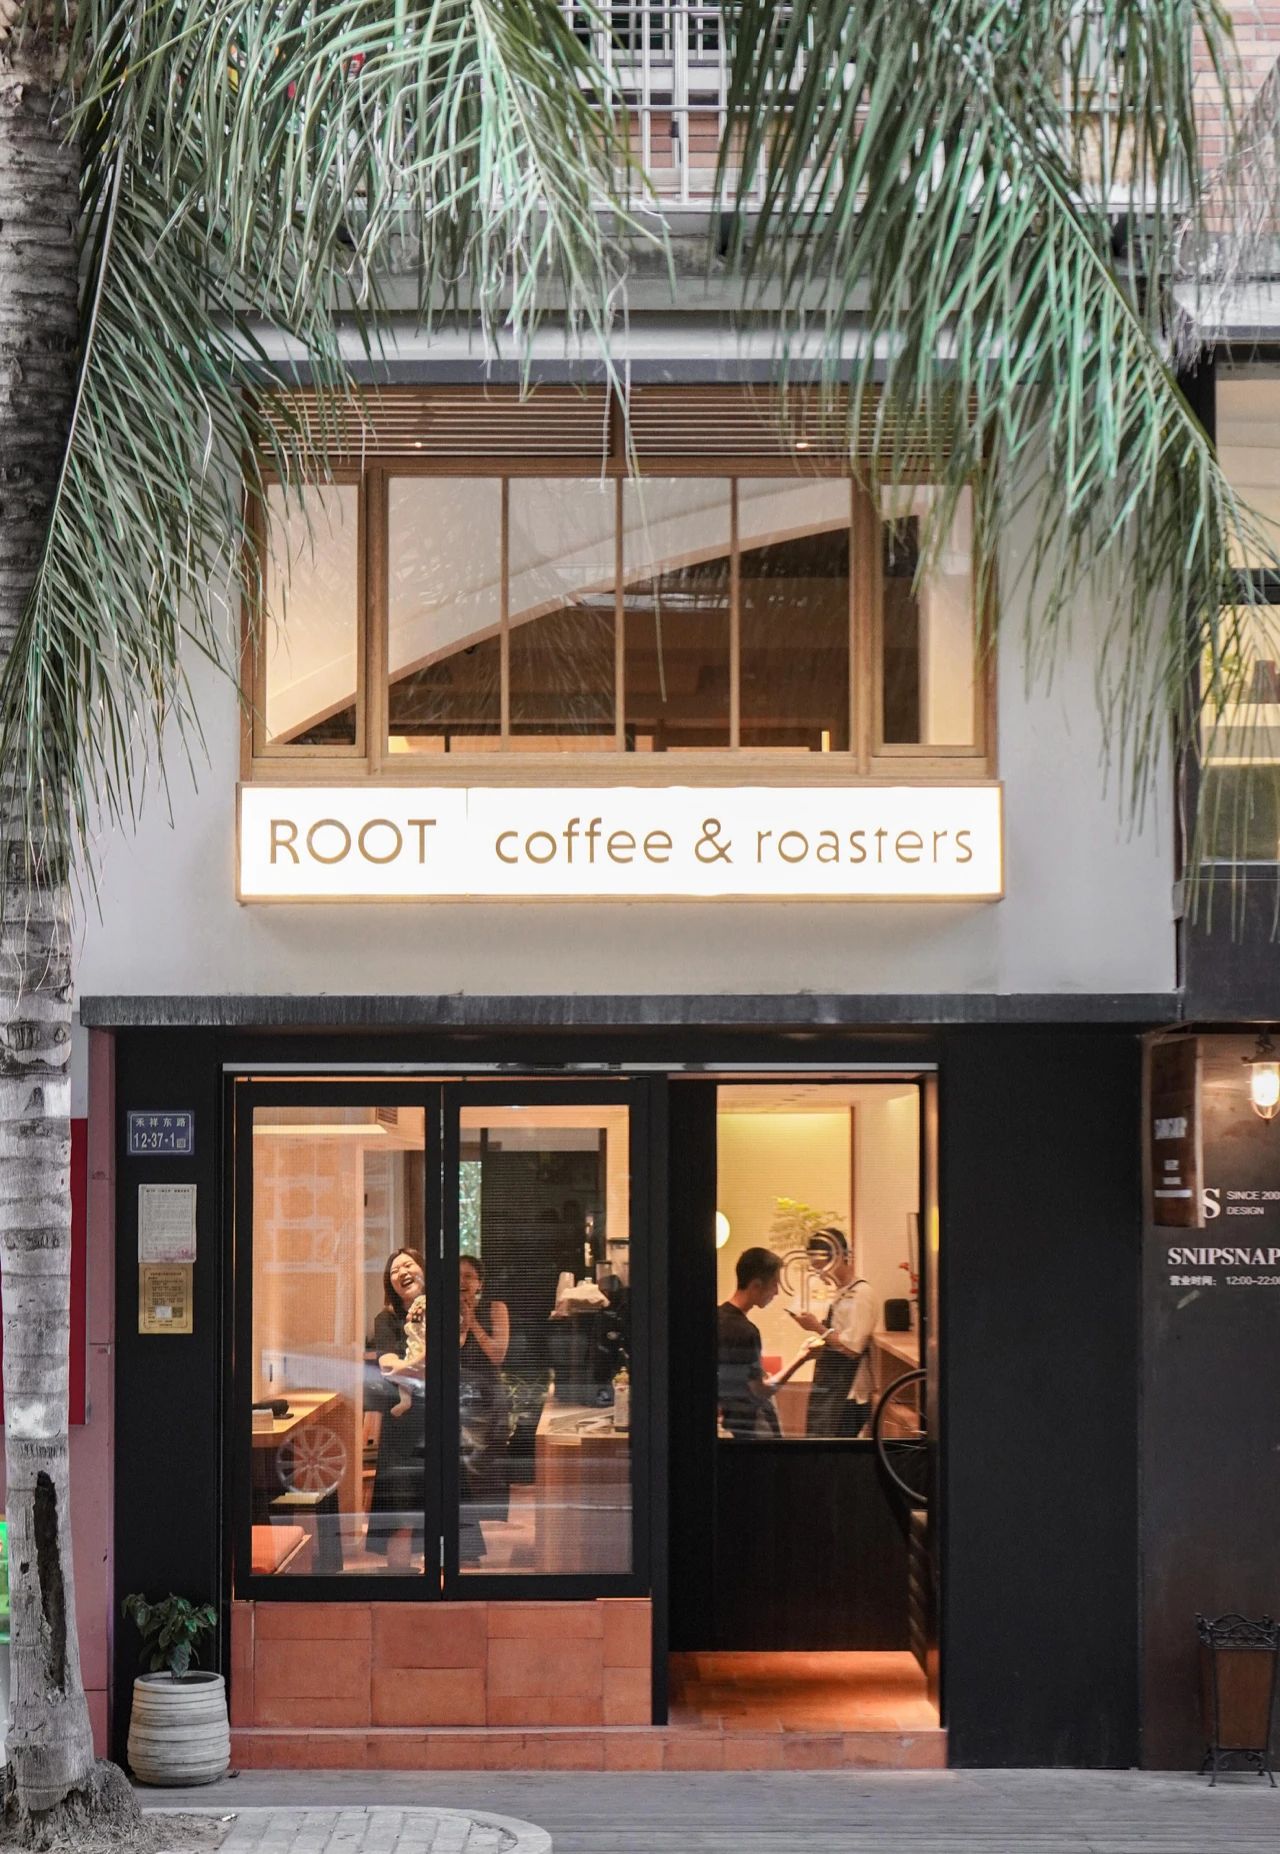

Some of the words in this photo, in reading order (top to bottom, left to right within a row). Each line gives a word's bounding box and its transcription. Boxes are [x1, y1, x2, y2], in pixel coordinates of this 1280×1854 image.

[269, 817, 437, 865] ROOT
[494, 816, 673, 865] coffee
[693, 816, 734, 865] &
[756, 826, 973, 865] roasters
[135, 1117, 186, 1127] 禾祥东路
[1226, 1190, 1260, 1200] SINCE
[1226, 1206, 1265, 1215] DESIGN
[1167, 1247, 1280, 1265] SNIPSNAP
[1225, 1275, 1280, 1285] 12:00-22:0
